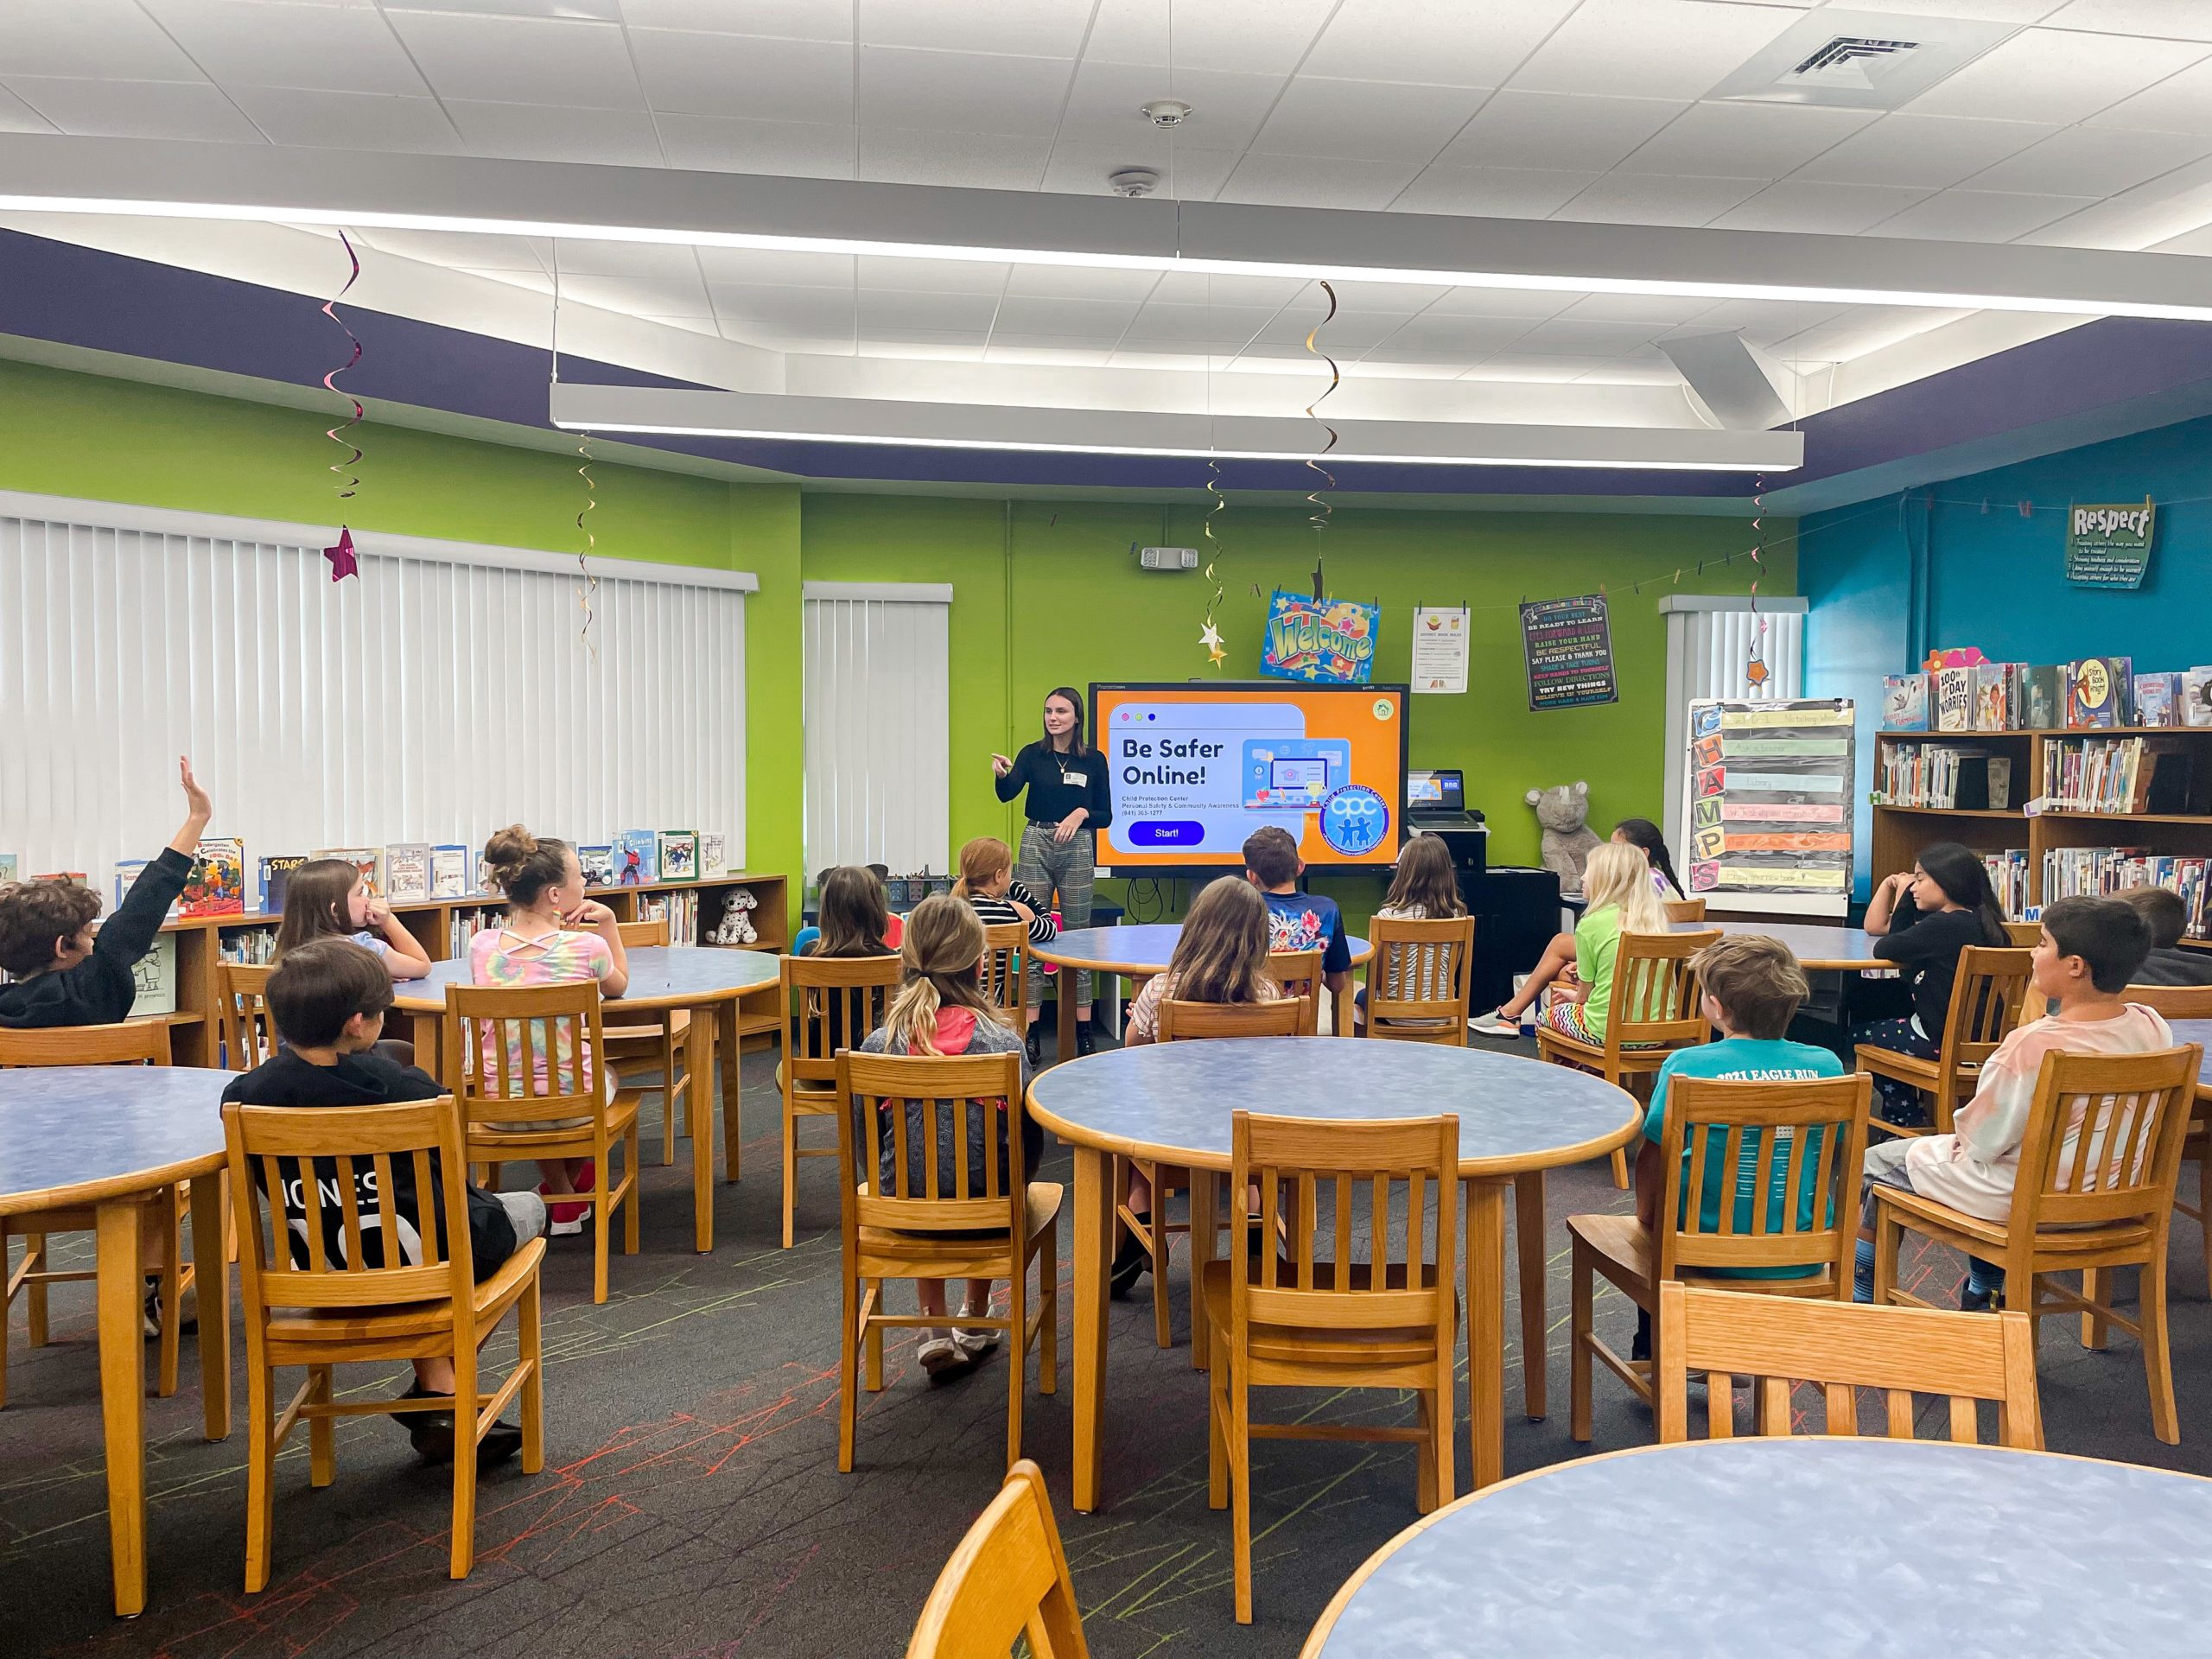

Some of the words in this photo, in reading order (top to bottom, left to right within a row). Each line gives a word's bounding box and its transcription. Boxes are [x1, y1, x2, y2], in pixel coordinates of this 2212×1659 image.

[2074, 508, 2150, 538] Respect
[1554, 613, 1569, 621] YOUR
[1539, 621, 1565, 630] READY
[1270, 615, 1372, 664] Welcome
[1535, 639, 1556, 648] RAISE
[1548, 642, 1601, 655] RESPECTFUL
[1545, 654, 1566, 663] PLEASE
[1535, 677, 1564, 687] FOLLOW
[1566, 672, 1610, 683] DIRECTIONS
[1576, 680, 1606, 690] THINGS
[1941, 671, 1961, 687] 100th
[1948, 680, 1967, 695] DAY
[1939, 694, 1967, 715] WORRIES
[1123, 739, 1152, 758] Be
[1160, 738, 1224, 758] Safer
[1123, 765, 1205, 785] Online!
[1323, 794, 1336, 809] Child
[1336, 785, 1370, 795] Protection
[1370, 790, 1387, 809] Center
[1870, 793, 1881, 804] H
[2025, 804, 2037, 817] L
[1154, 829, 1179, 837] Start!
[629, 837, 652, 847] Climbing
[2025, 908, 2039, 921] M
[1717, 1071, 1749, 1081] 2021
[1751, 1070, 1794, 1081] EAGLE
[1794, 1069, 1819, 1080] RUN
